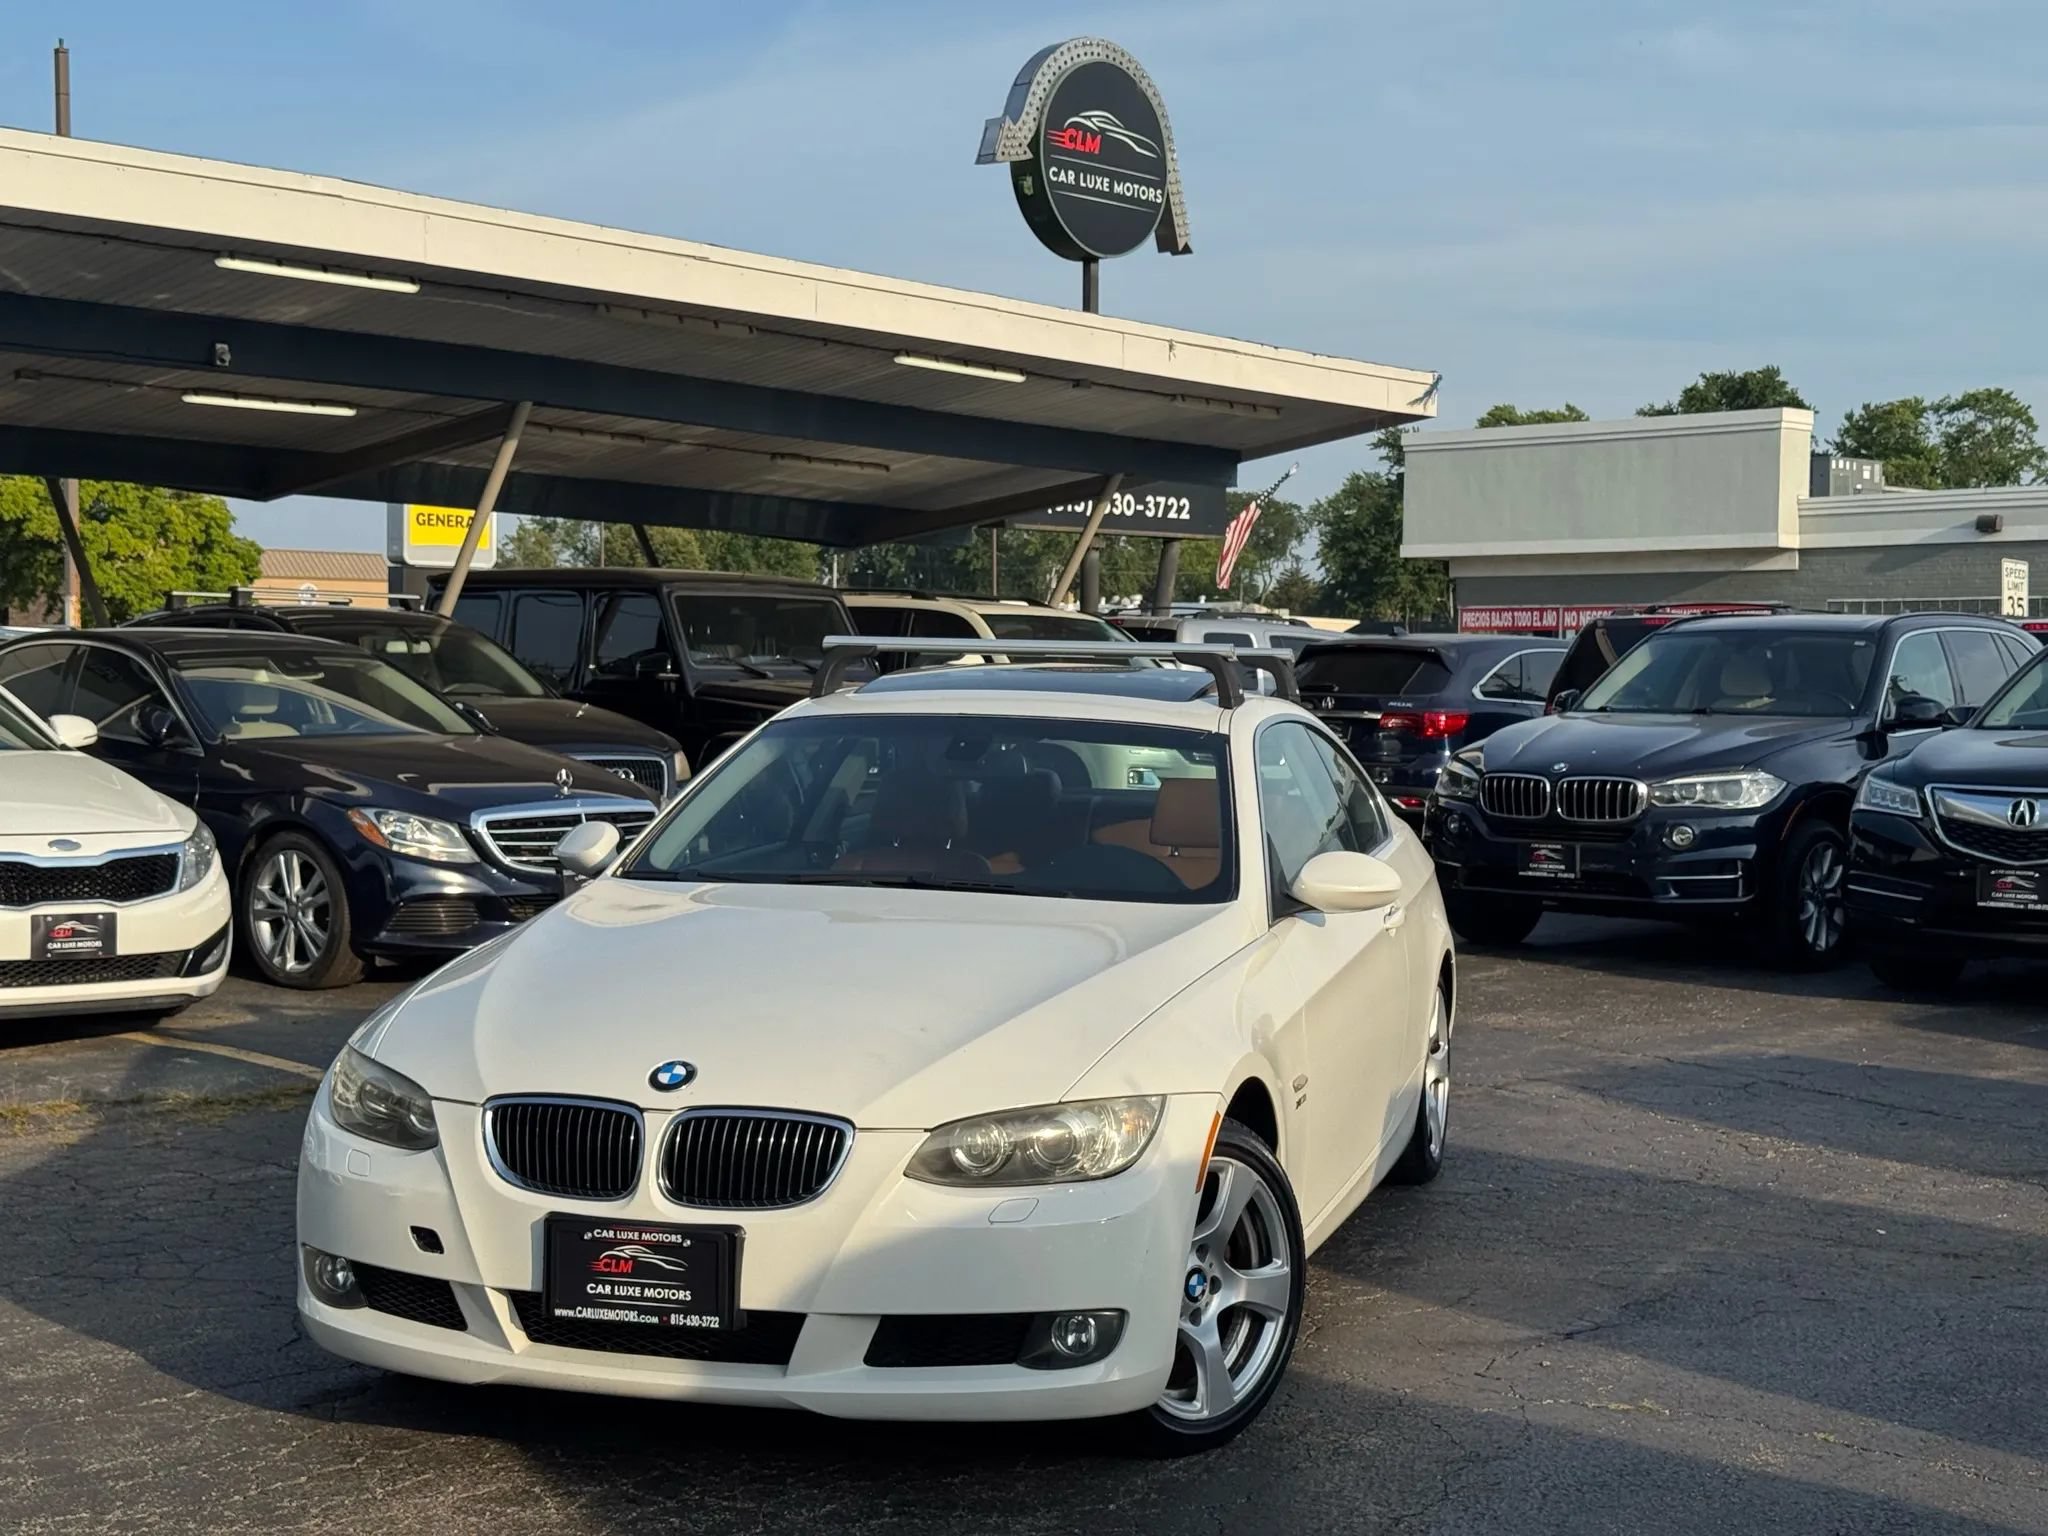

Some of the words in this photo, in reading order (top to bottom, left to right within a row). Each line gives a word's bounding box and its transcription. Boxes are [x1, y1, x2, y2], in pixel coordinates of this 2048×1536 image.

[1064, 127, 1102, 154] CLM
[1049, 166, 1076, 185] CAR
[1080, 173, 1110, 192] LUXE
[1114, 180, 1163, 204] MOTORS
[416, 513, 475, 528] GENERA
[2005, 567, 2025, 579] SPEED
[2007, 580, 2024, 592] LIMIT
[2007, 596, 2024, 617] 35
[1462, 612, 1490, 628] PRECIOS
[1491, 612, 1512, 628] BAJOS
[1514, 611, 1532, 627] TODO
[1533, 611, 1541, 627] EL
[1564, 610, 1577, 628] NO
[593, 1228, 614, 1239] CAR
[616, 1231, 640, 1241] LUXE
[641, 1233, 683, 1244] MOTORS
[600, 1259, 633, 1274] CLM
[586, 1283, 611, 1295] CAR
[614, 1285, 642, 1298] LUXE
[644, 1287, 692, 1301] MOTORS
[670, 1312, 720, 1329] 815-630-3722
